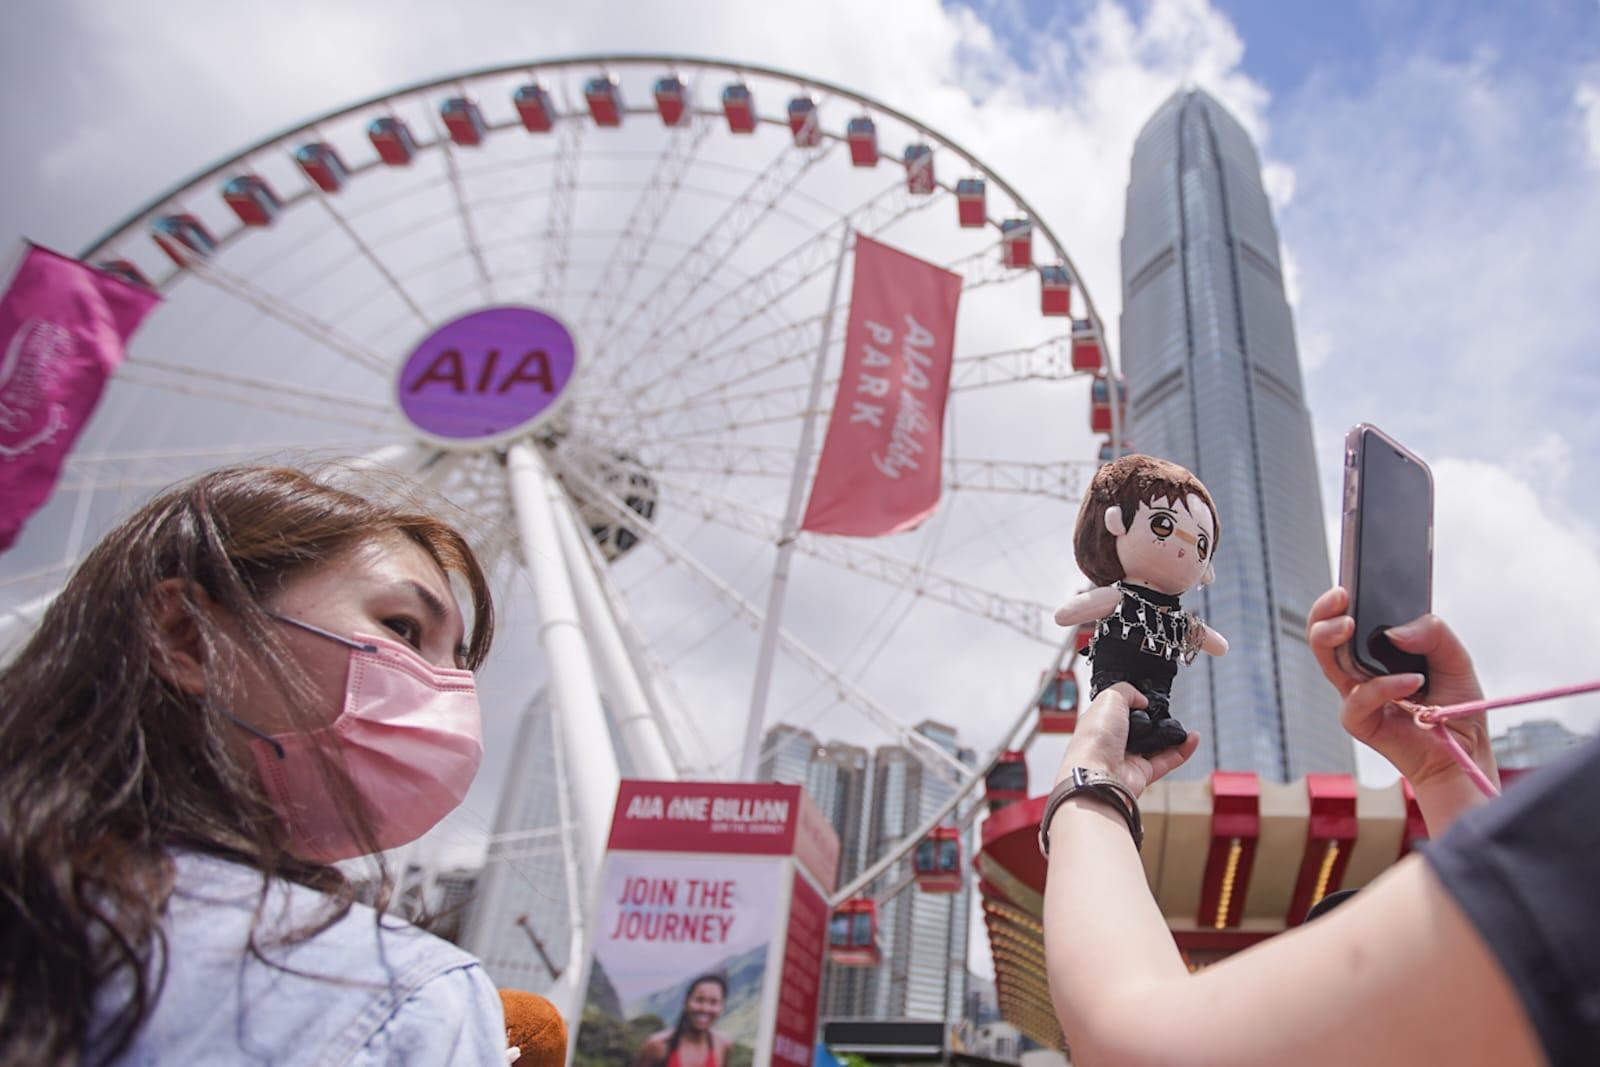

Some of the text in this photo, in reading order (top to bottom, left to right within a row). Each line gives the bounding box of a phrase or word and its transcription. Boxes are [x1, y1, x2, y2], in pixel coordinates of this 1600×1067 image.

[903, 314, 935, 389] AIA
[409, 348, 556, 394] AIA
[850, 320, 893, 427] PARK
[626, 795, 663, 819] AIA
[712, 797, 789, 823] BILLION
[619, 877, 735, 908] JOIN THE
[612, 913, 735, 944] JOURNEY
